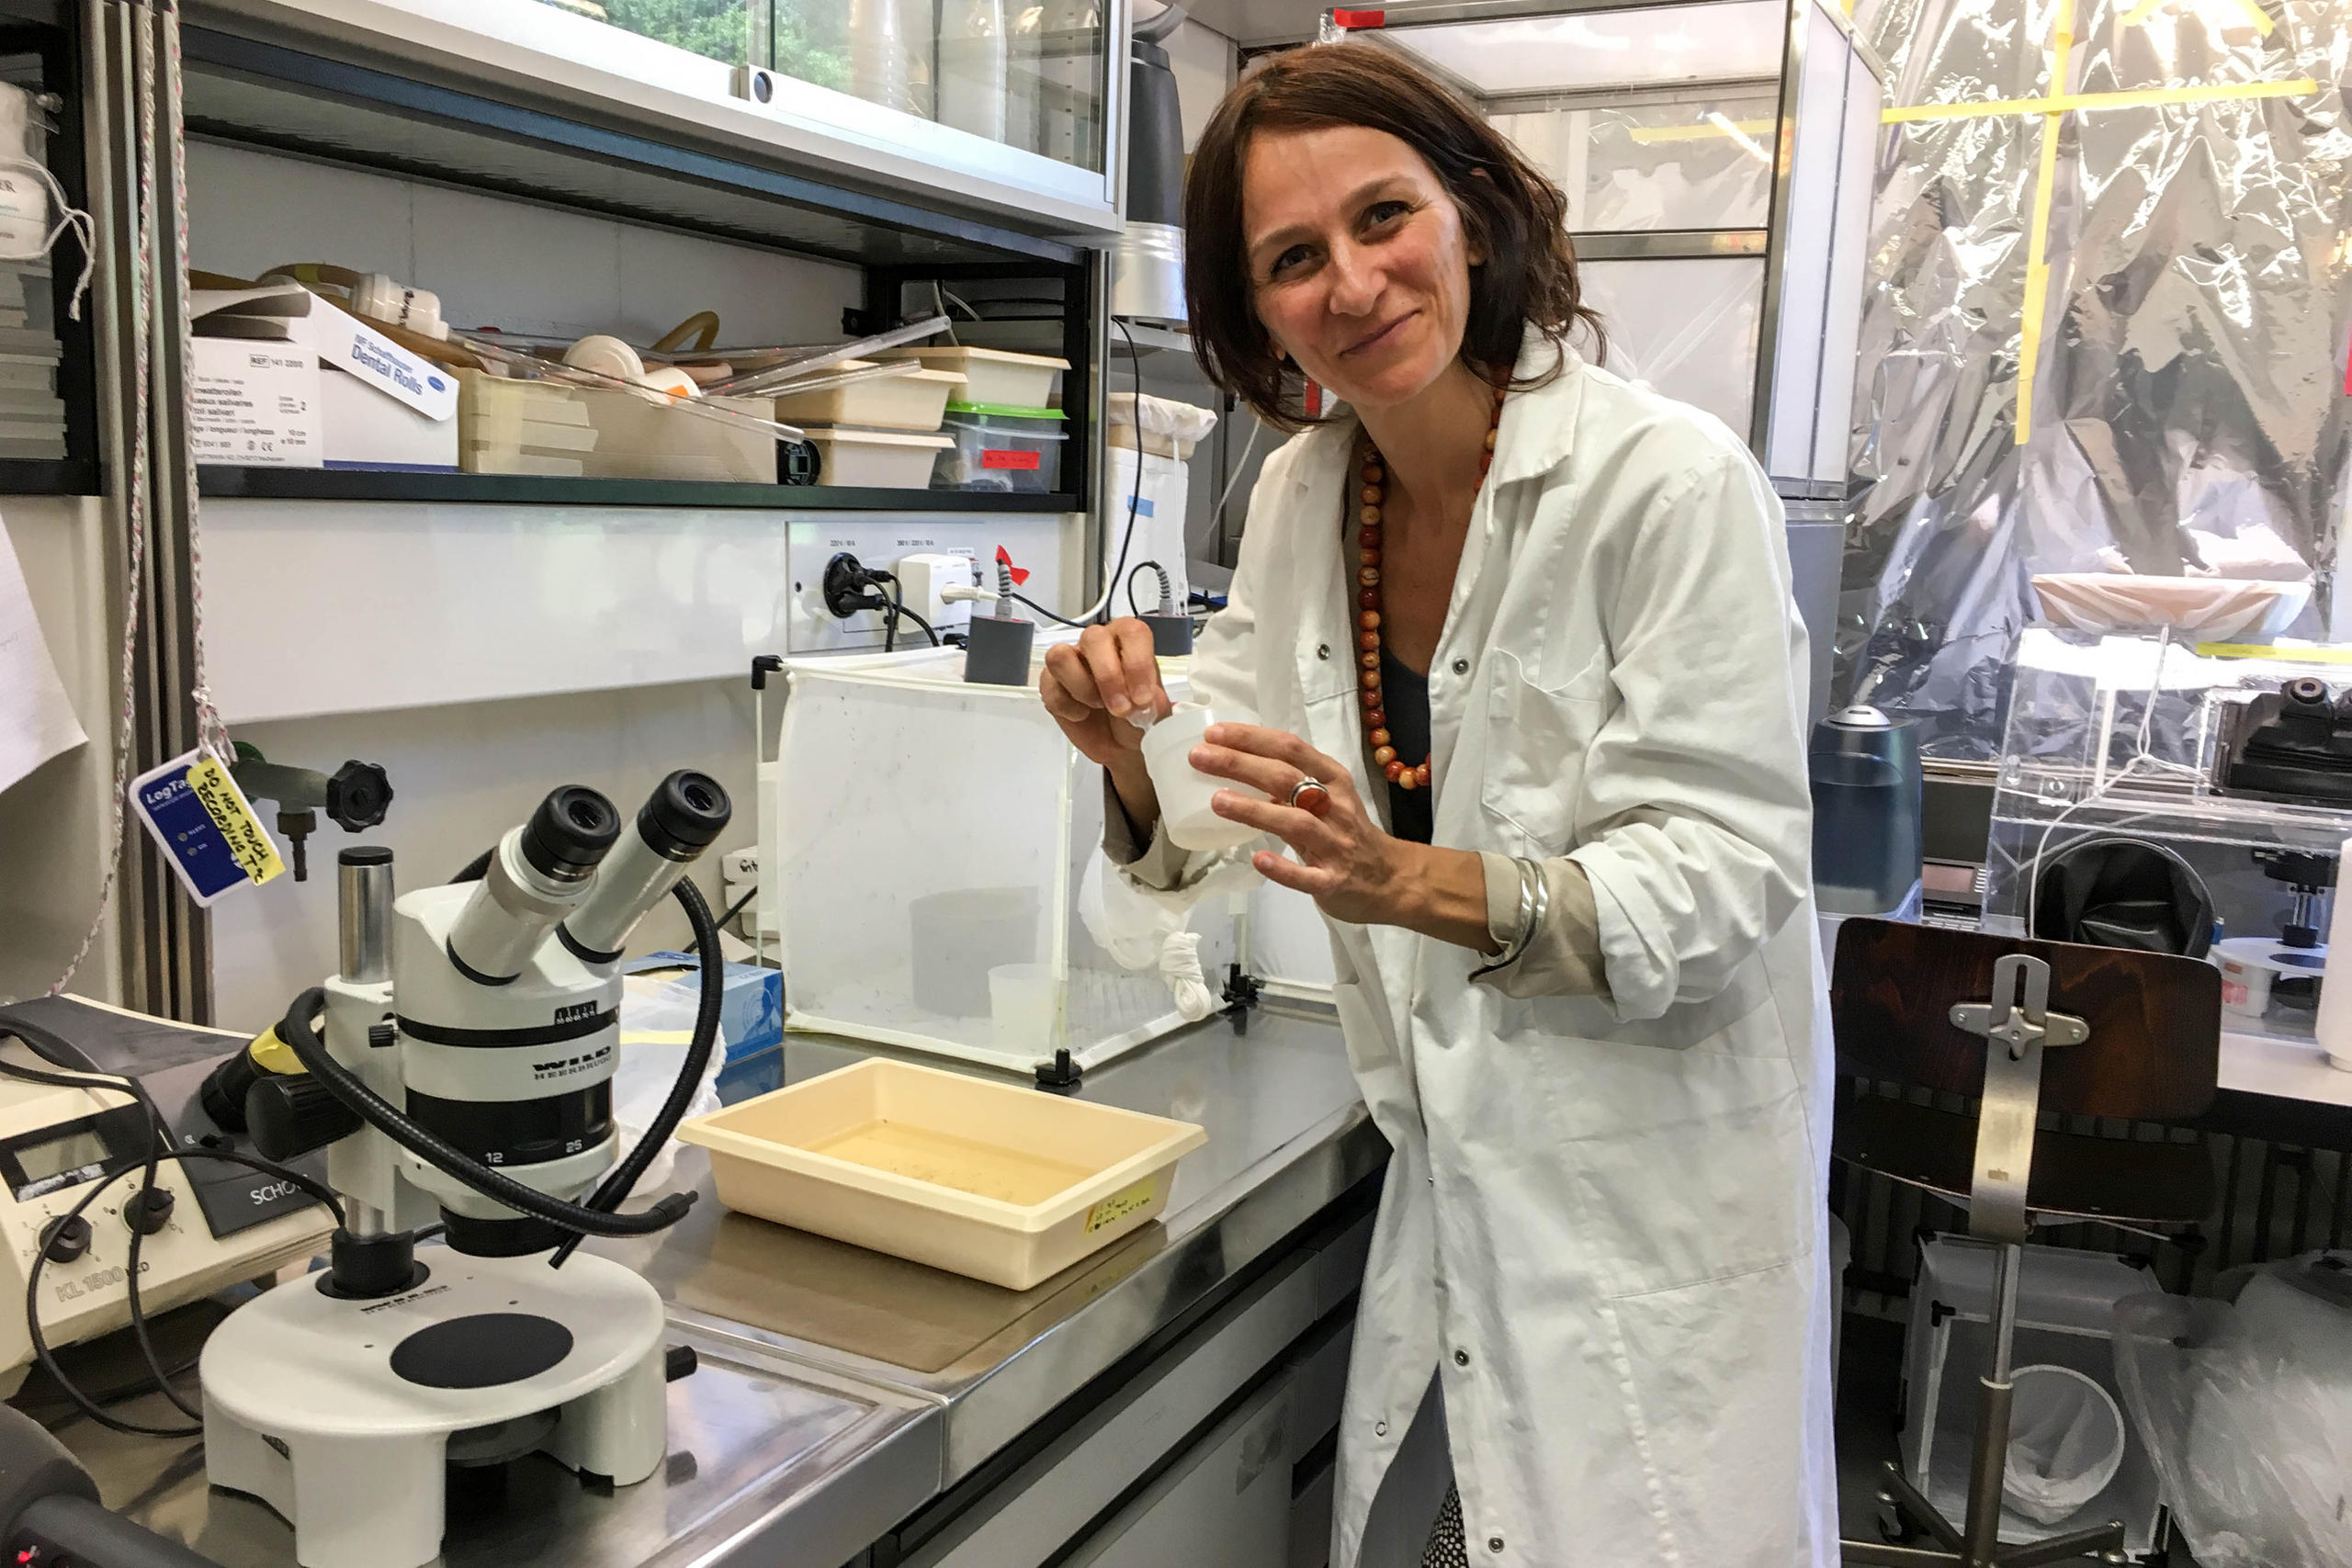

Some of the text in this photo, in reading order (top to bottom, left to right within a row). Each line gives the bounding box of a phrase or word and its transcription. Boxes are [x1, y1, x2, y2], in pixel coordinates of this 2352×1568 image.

[351, 344, 391, 378] Dental
[393, 367, 423, 396] Rolls
[198, 782, 246, 853] RECORDING
[204, 767, 269, 861] DO NOT TOUCH
[532, 1045, 611, 1072] WILD
[485, 1139, 582, 1163] 12 25
[56, 1281, 85, 1303] KL
[83, 1266, 125, 1292] 1500
